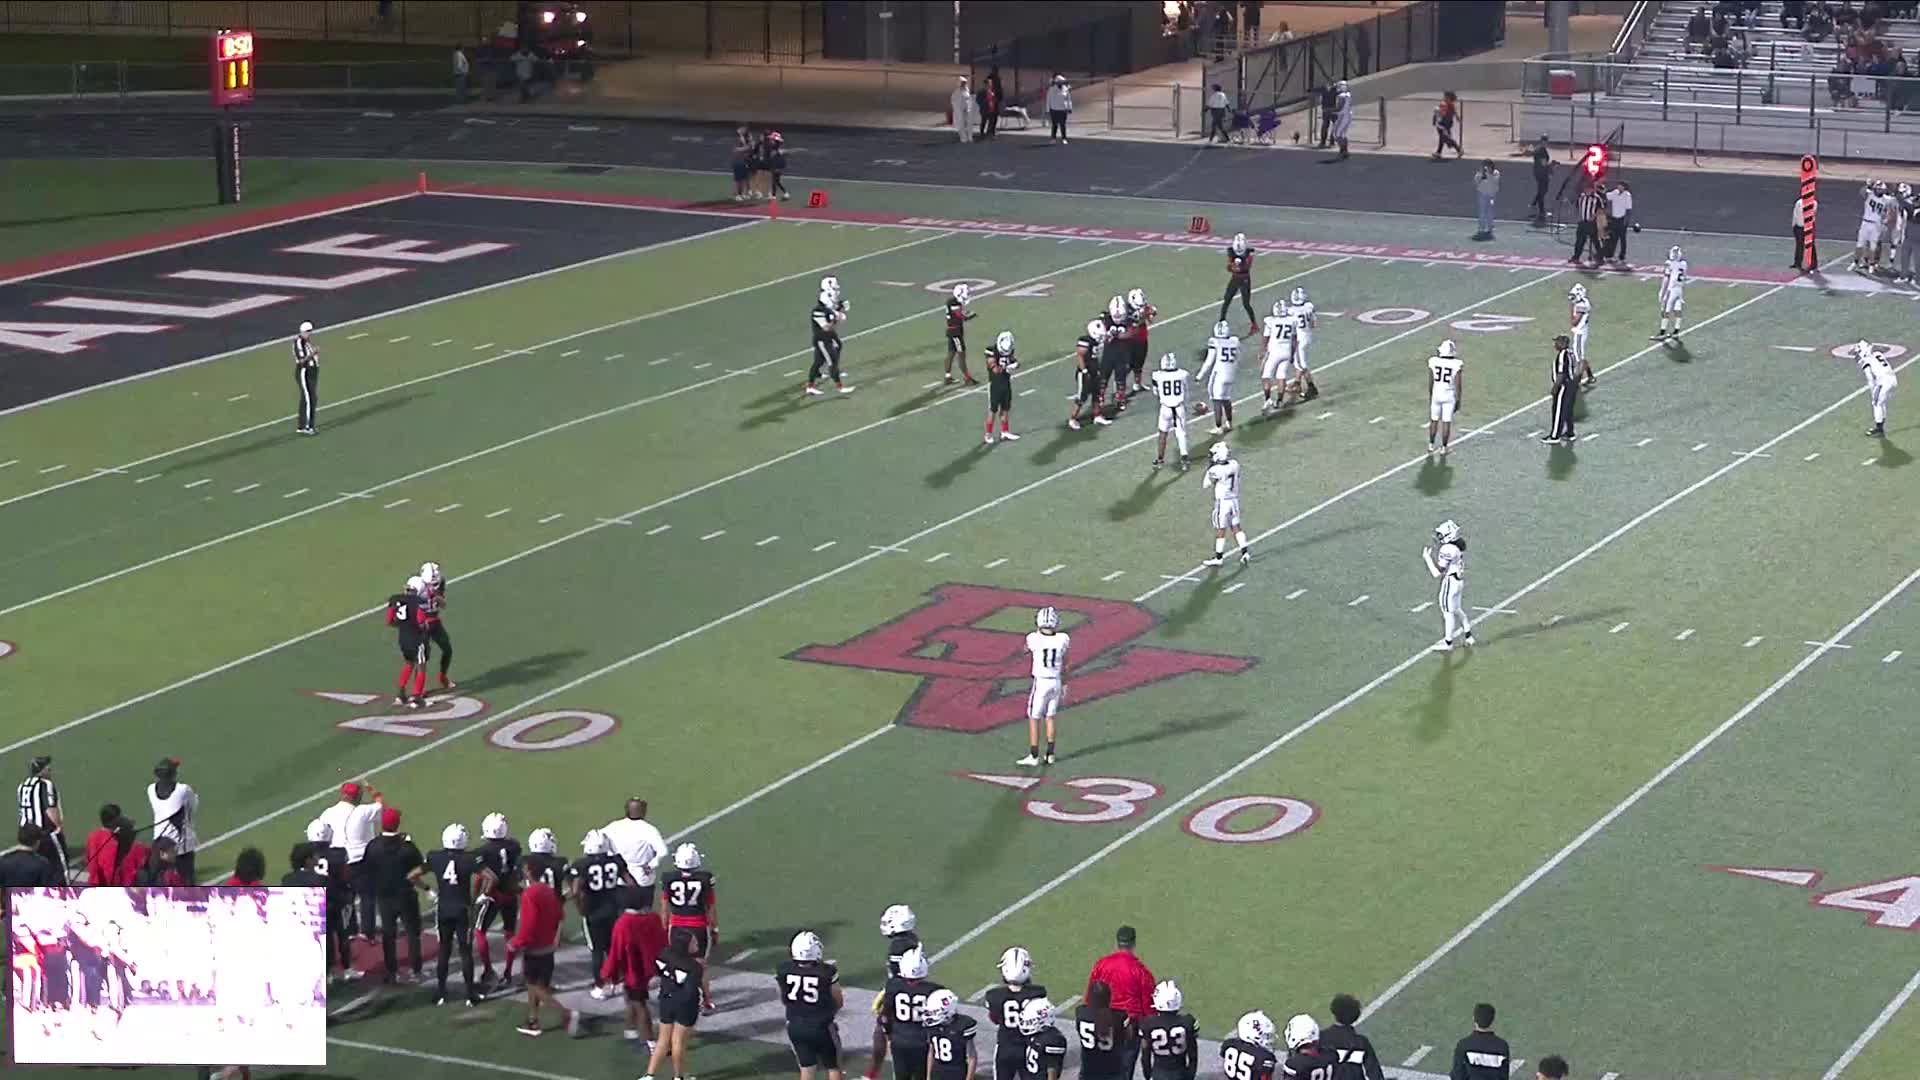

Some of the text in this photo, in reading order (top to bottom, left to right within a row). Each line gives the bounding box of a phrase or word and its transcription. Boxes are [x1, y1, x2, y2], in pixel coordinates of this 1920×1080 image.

[229, 60, 249, 88] 11
[1588, 146, 1602, 176] 2
[811, 192, 821, 207] G
[899, 216, 1112, 236] STADIUM
[1192, 216, 1204, 230] 10
[1275, 324, 1292, 339] 72
[1356, 307, 1537, 331] 20
[1221, 347, 1236, 362] 55
[1434, 366, 1452, 383] 32
[1162, 380, 1182, 396] 88
[396, 601, 408, 620] 3
[1043, 648, 1057, 667] 11
[336, 697, 620, 750] 20
[1022, 776, 1319, 842] 30
[443, 860, 458, 885] 4
[588, 862, 618, 891] 33
[670, 881, 702, 906] 37
[786, 974, 819, 1003] 75
[932, 1036, 952, 1062] 18
[1151, 1026, 1187, 1055] 23
[1224, 1047, 1255, 1080] 85
